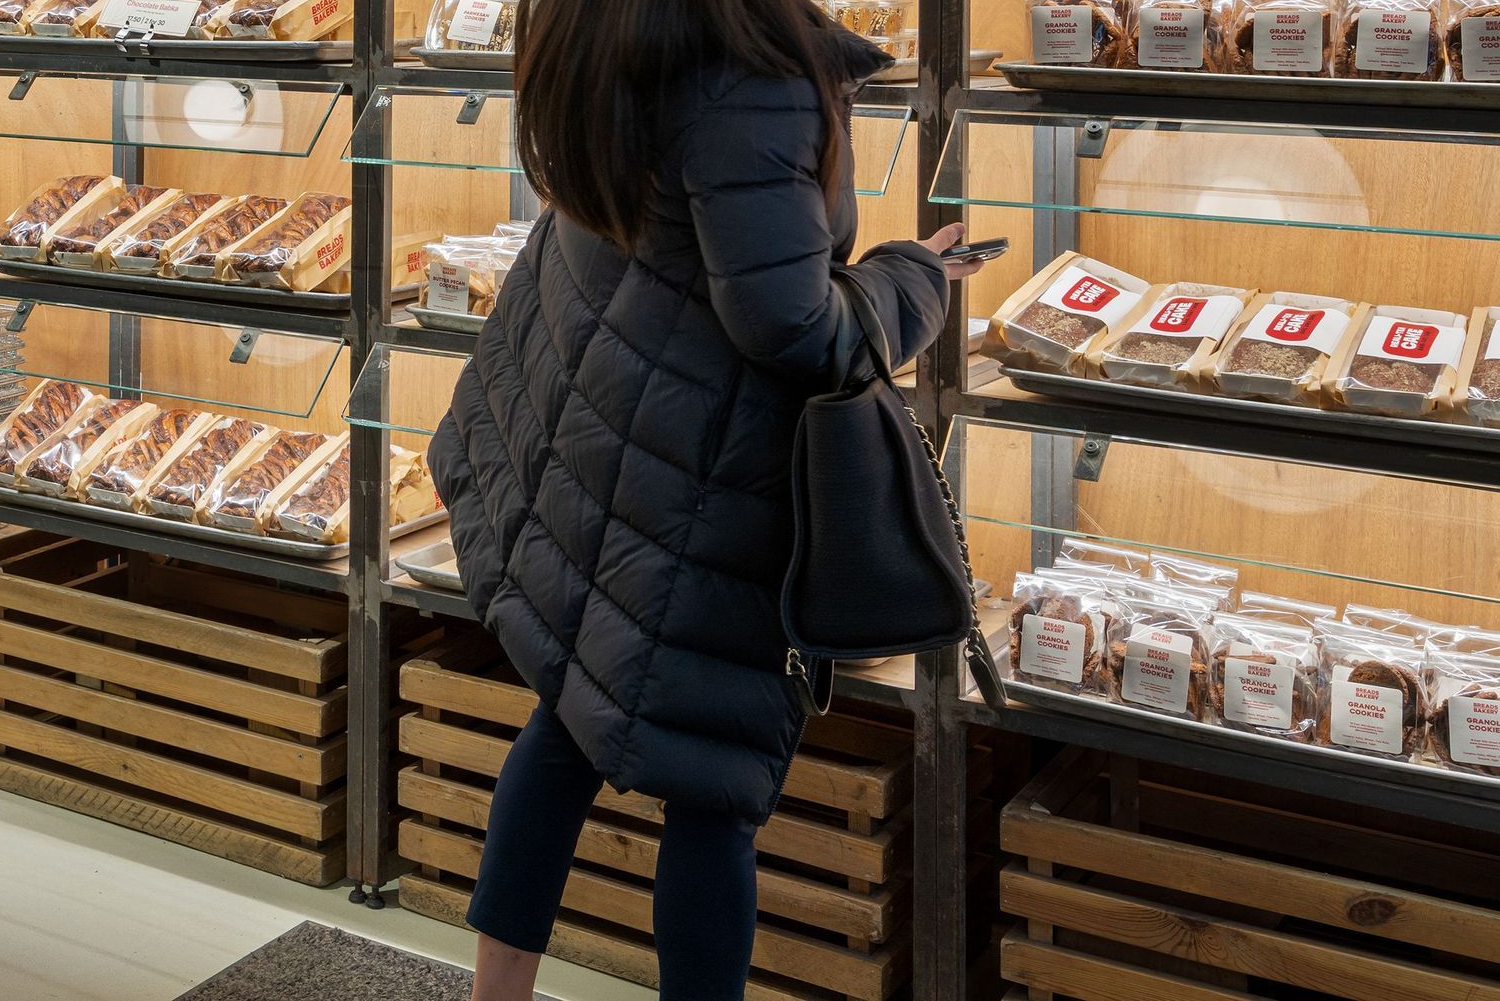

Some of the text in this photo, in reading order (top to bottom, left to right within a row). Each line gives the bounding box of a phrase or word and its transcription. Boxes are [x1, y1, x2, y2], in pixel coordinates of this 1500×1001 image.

[127, 0, 159, 10] Chocolate
[313, 3, 339, 25] BAKERY
[463, 10, 490, 18] PARMESAN
[317, 234, 344, 258] BREADS
[319, 246, 344, 269] BAKERY
[433, 276, 450, 284] BUTTER
[439, 282, 458, 290] COOKIES
[1079, 284, 1105, 303] CAKE
[1168, 302, 1193, 325] CAKE
[1284, 314, 1309, 333] CAKE
[1401, 328, 1424, 349] CAKE
[1043, 626, 1064, 634] BAKERY
[1044, 622, 1065, 630] BREADS
[1036, 634, 1070, 645] GRANOLA
[1037, 641, 1068, 651] COOKIES
[1147, 649, 1169, 658] BREADS
[1147, 654, 1169, 662] BAKERY
[1140, 661, 1175, 674] GRANOLA
[1248, 665, 1271, 673] BREADS
[1141, 668, 1173, 679] COOKIES
[1240, 678, 1277, 690] GRANOLA
[1242, 686, 1275, 696] COOKIES
[1356, 688, 1379, 696] BREADS
[1356, 693, 1379, 701] BAKERY
[1348, 701, 1386, 713] GRANOLA
[1350, 708, 1385, 719] COOKIES
[1467, 718, 1500, 726] GRANOL
[1469, 725, 1500, 733] COOKIE
